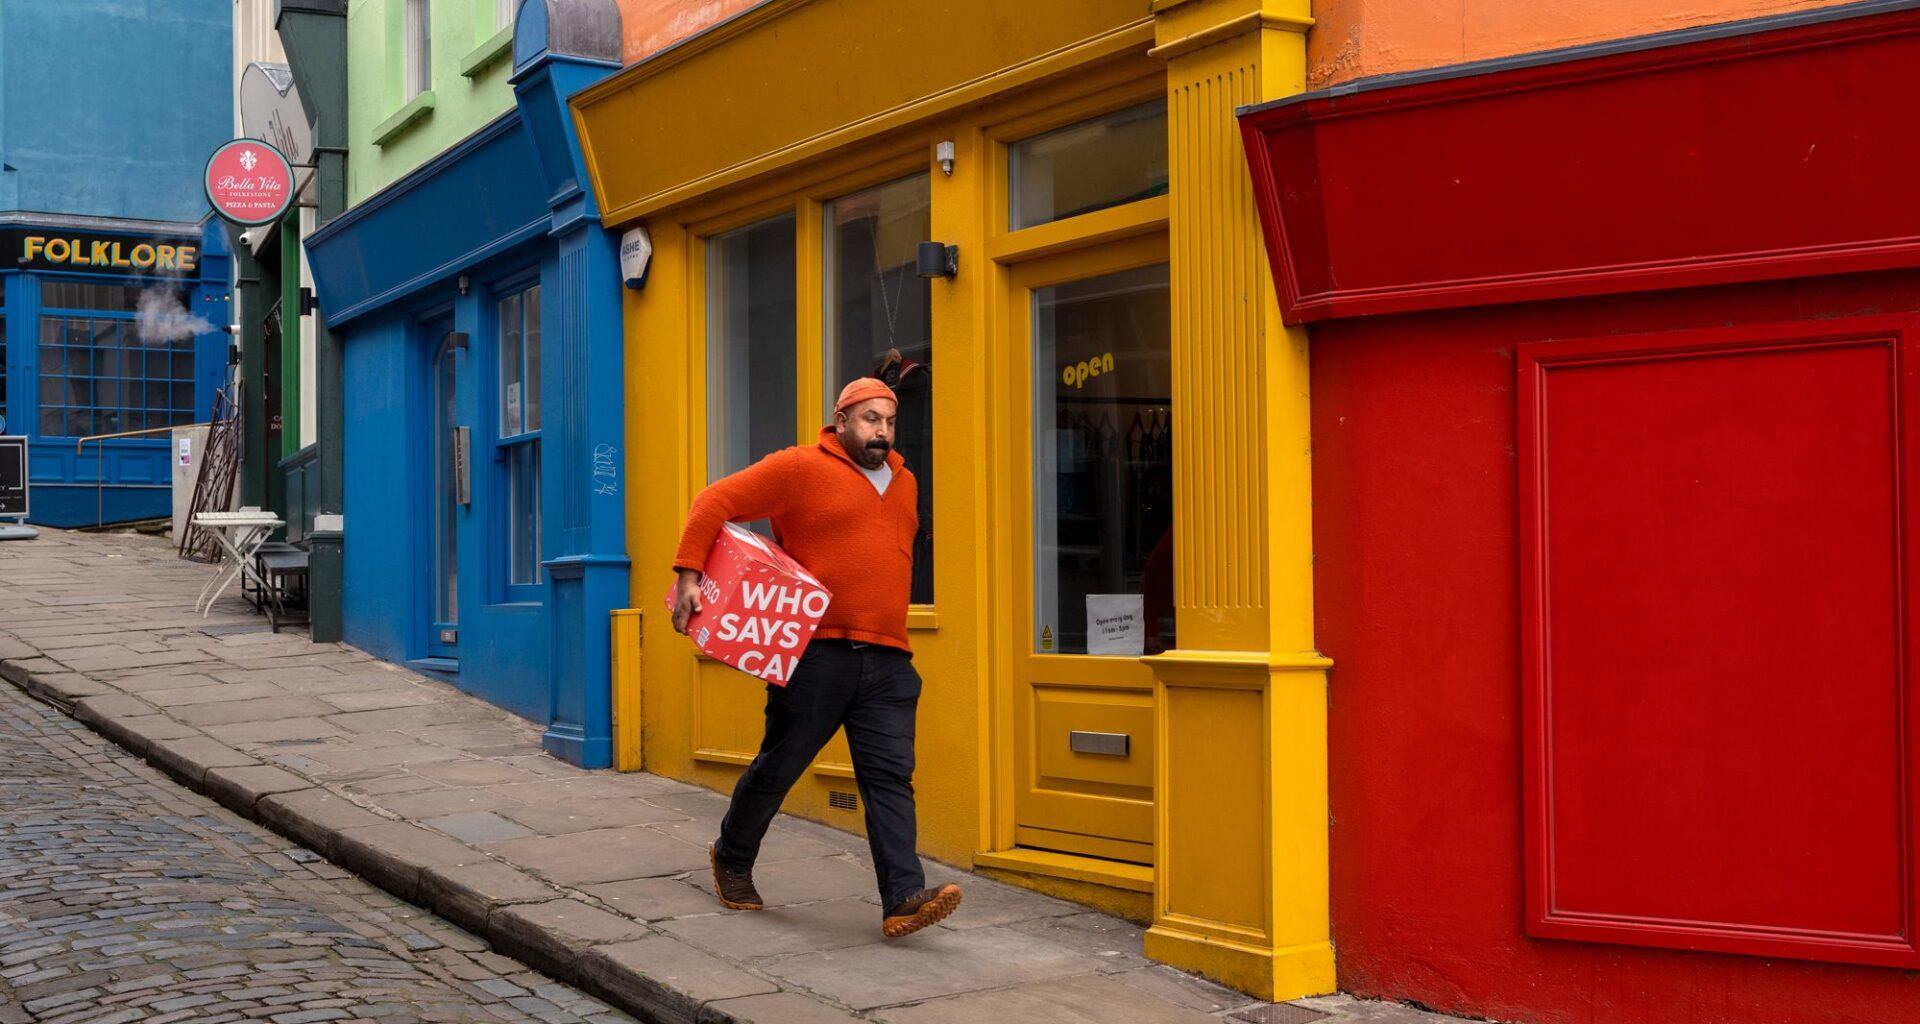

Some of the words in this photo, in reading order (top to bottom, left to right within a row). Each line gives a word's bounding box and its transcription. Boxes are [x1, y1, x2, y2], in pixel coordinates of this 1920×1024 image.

[217, 175, 255, 190] Bella
[258, 176, 281, 190] Vita
[24, 236, 196, 271] FOLKLORE
[1063, 352, 1114, 389] open
[742, 580, 830, 618] WHO
[716, 613, 801, 649] SAYS
